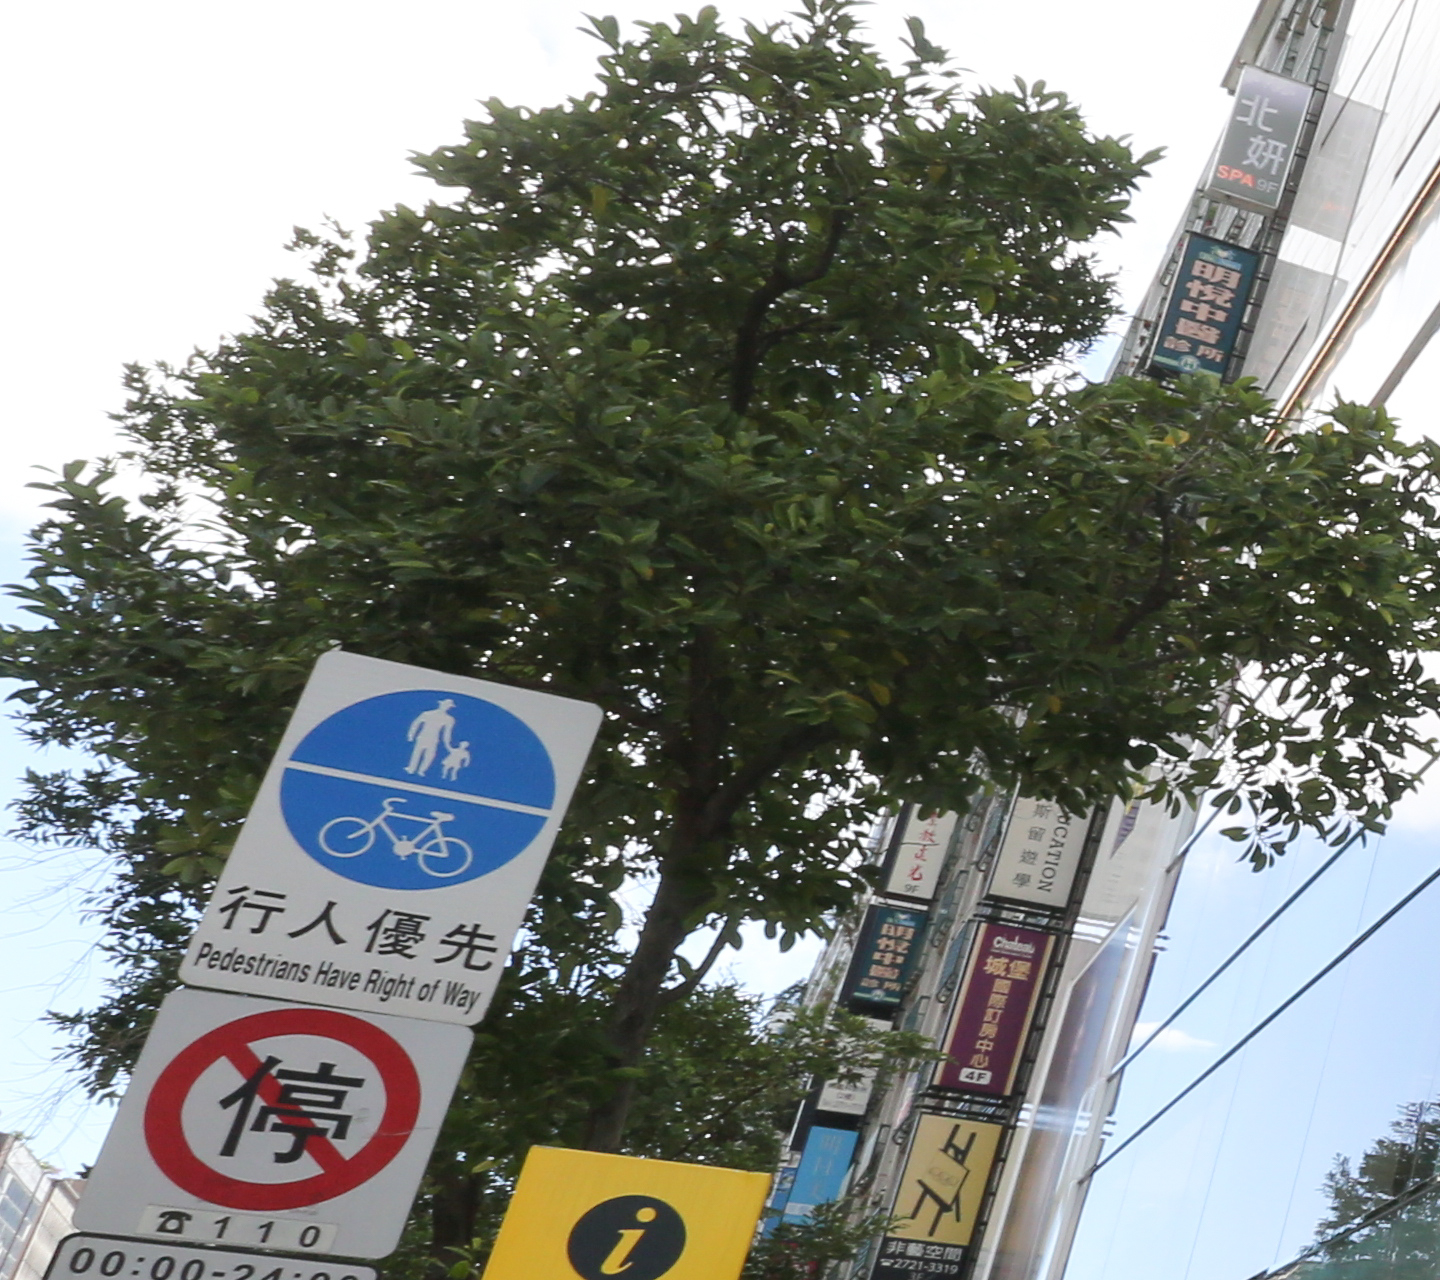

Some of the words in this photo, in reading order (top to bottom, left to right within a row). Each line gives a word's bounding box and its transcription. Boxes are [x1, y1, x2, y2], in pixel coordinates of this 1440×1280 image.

[1216, 165, 1256, 188] SPA
[1256, 179, 1279, 194] 9F
[218, 885, 499, 972] 行人優先
[194, 942, 310, 984] Pedestrians
[313, 961, 361, 992] Have
[363, 970, 415, 1005] Right
[418, 978, 442, 1003] of
[443, 983, 482, 1015] Way
[985, 955, 1033, 982] 城堡
[964, 1071, 987, 1084] 4F
[218, 1054, 366, 1164] 停
[892, 1258, 960, 1275] 2721-3319
